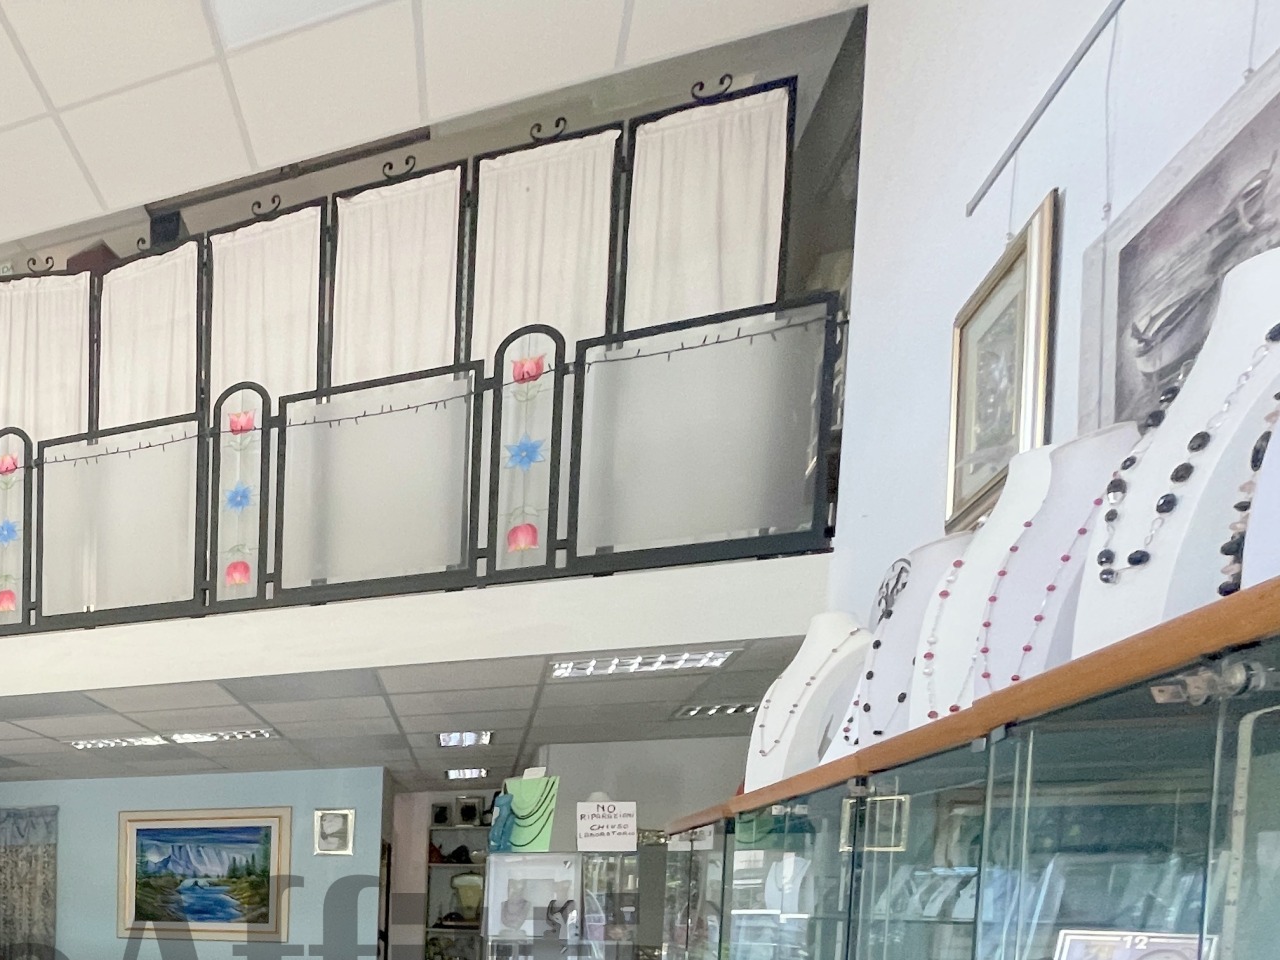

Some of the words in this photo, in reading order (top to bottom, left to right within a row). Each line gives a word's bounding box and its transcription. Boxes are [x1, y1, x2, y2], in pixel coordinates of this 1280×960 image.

[596, 804, 616, 813] NO
[589, 823, 629, 831] CHIUSO
[1122, 936, 1149, 950] 12
